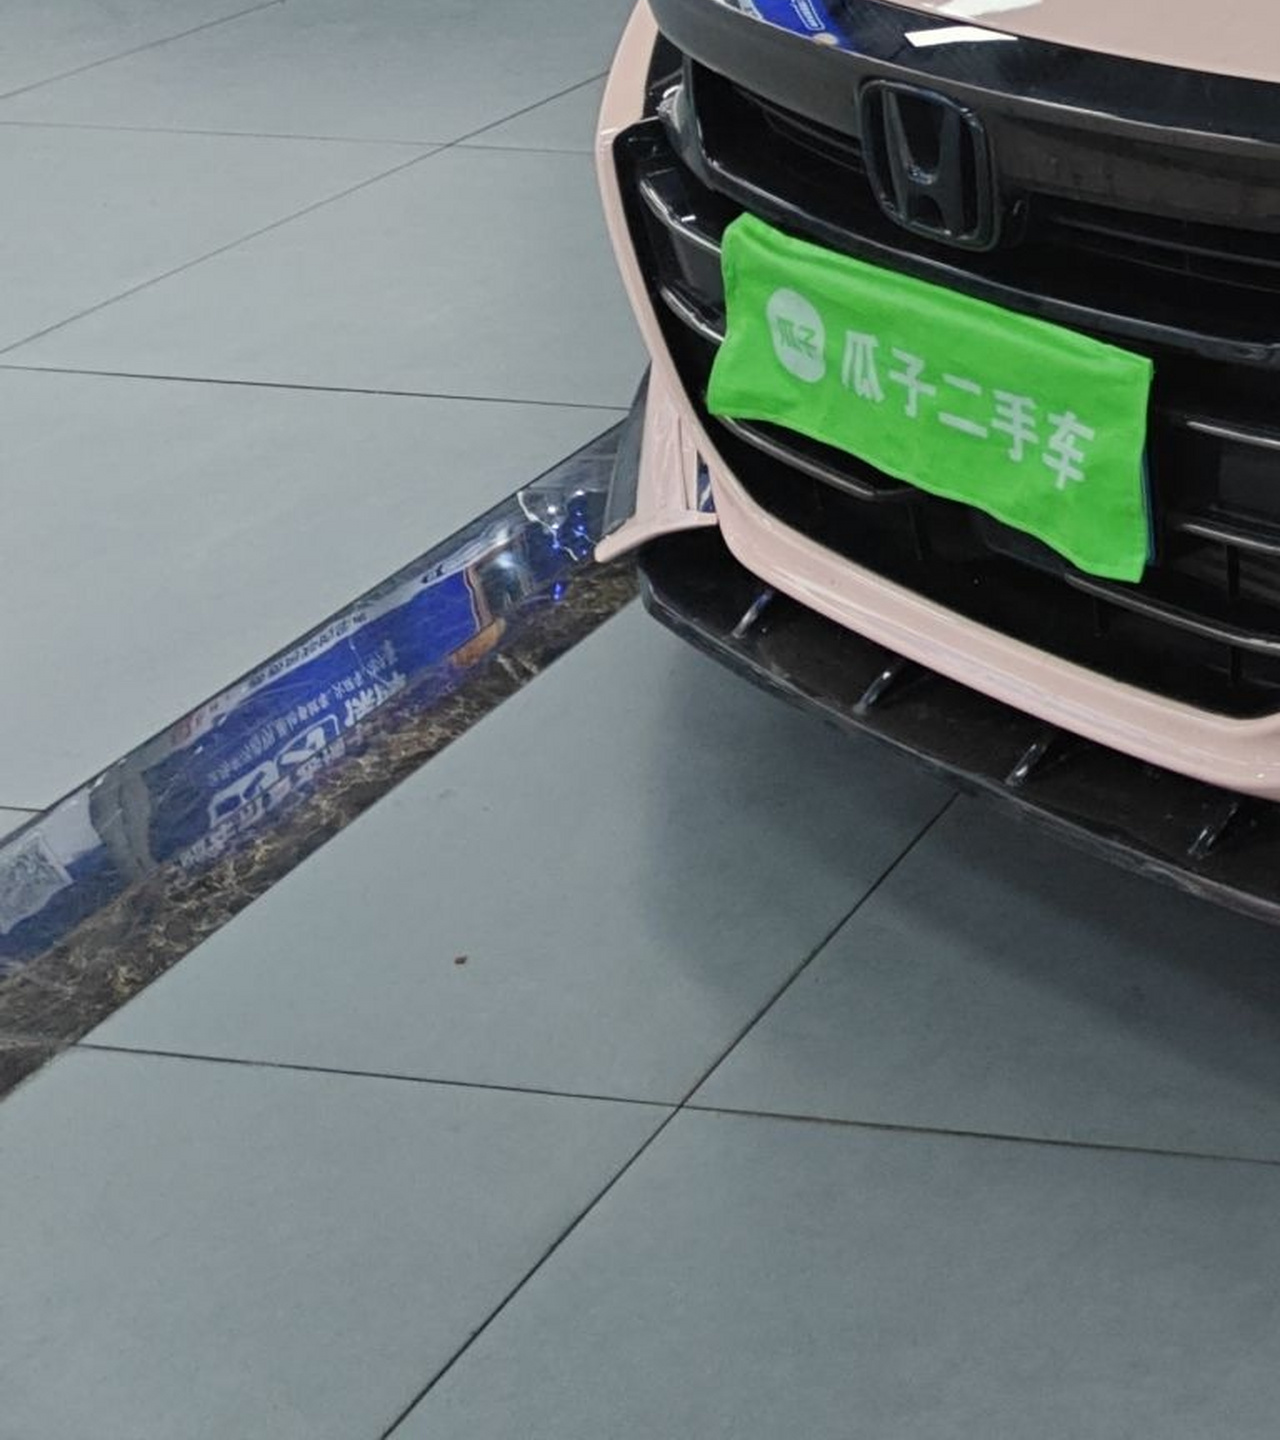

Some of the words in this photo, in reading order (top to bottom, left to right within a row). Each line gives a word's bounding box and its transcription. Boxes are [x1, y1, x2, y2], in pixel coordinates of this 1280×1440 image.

[841, 329, 1095, 490] 瓜子二手车
